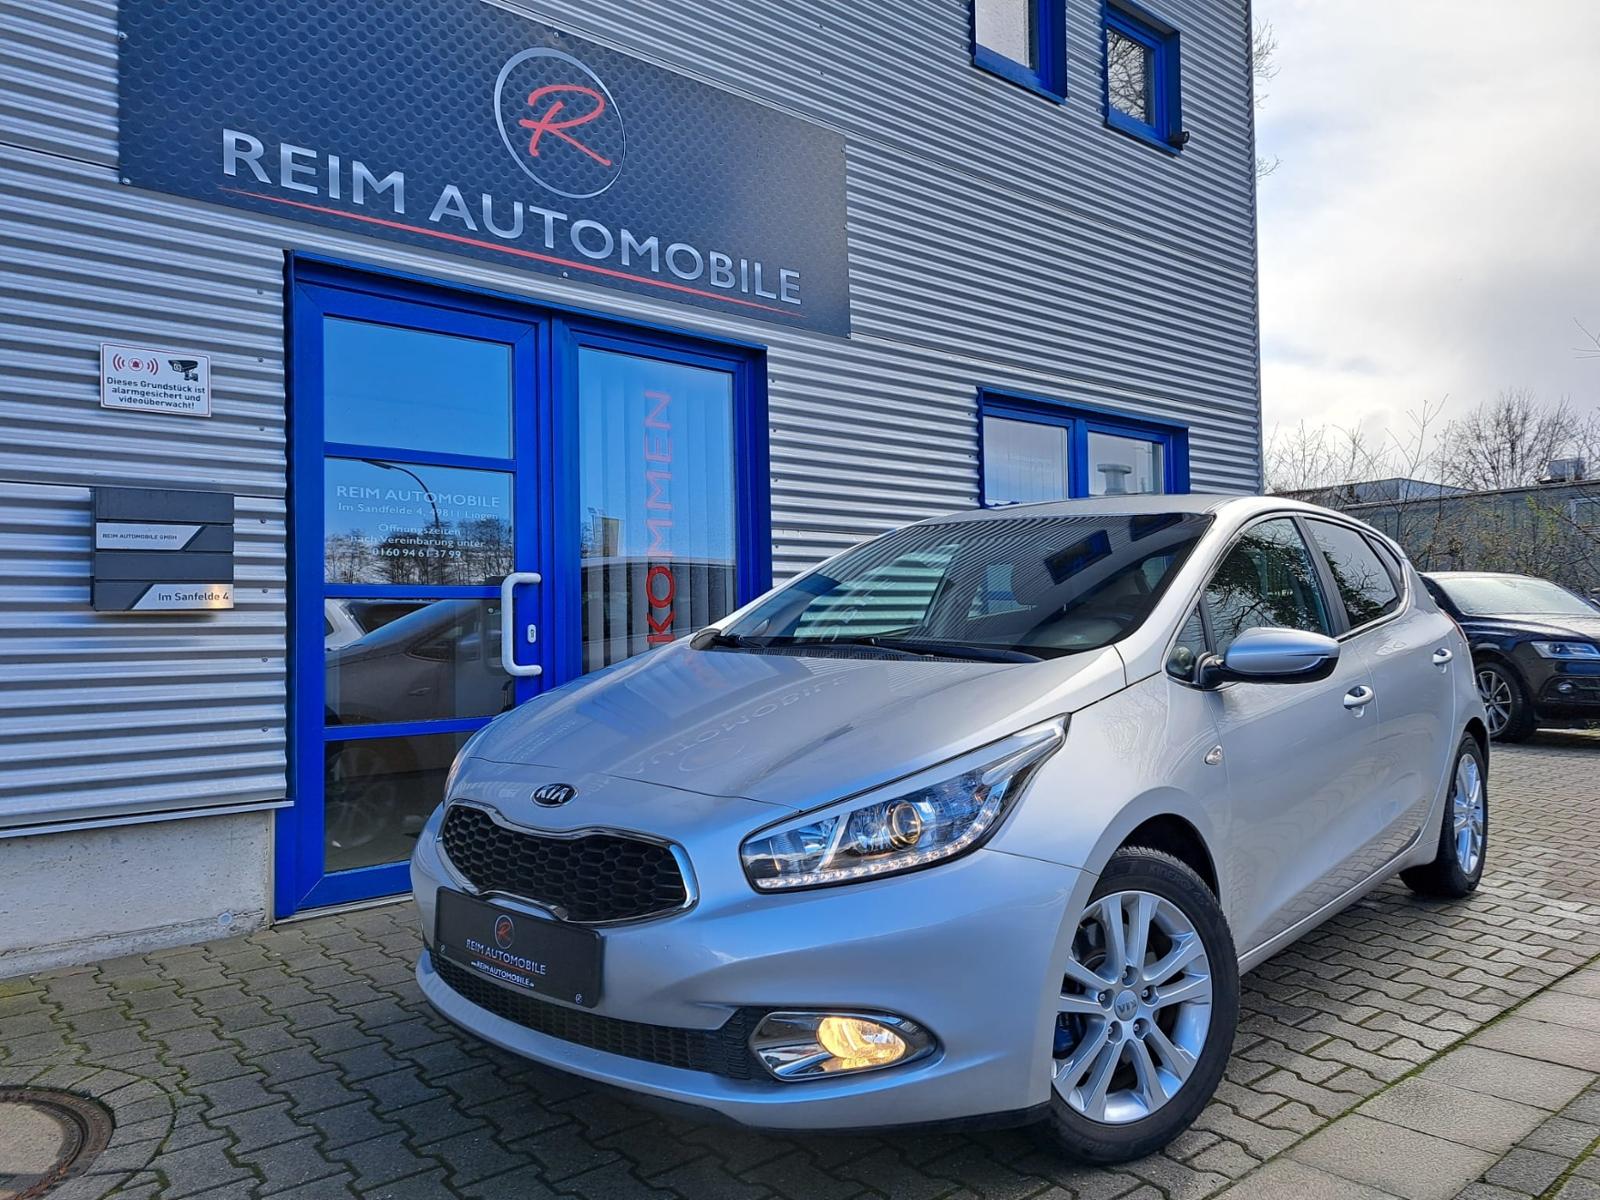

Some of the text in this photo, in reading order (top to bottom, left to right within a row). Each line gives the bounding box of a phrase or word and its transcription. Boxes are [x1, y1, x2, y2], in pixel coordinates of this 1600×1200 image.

[518, 84, 612, 167] R
[222, 128, 803, 305] REIM AUTOMOBILE
[106, 376, 206, 394] Dieses Grundstück ist
[111, 386, 201, 402] alarmgesichert und
[118, 396, 195, 409] videoüberwacht!
[336, 485, 501, 508] REIM AUTOMOBILE
[337, 502, 354, 512] Im
[357, 503, 413, 515] Sandfelde
[465, 511, 498, 522] Lingen
[643, 390, 677, 645] KOMMEN
[379, 535, 454, 549] Vereinbarung
[457, 540, 485, 549] unter
[372, 547, 400, 557] 0160
[402, 548, 416, 558] 94
[158, 591, 229, 601] Im Sanfelde 4
[536, 786, 570, 803] KIA
[465, 938, 484, 954] REIM
[485, 947, 547, 975] AUTOMOBILE
